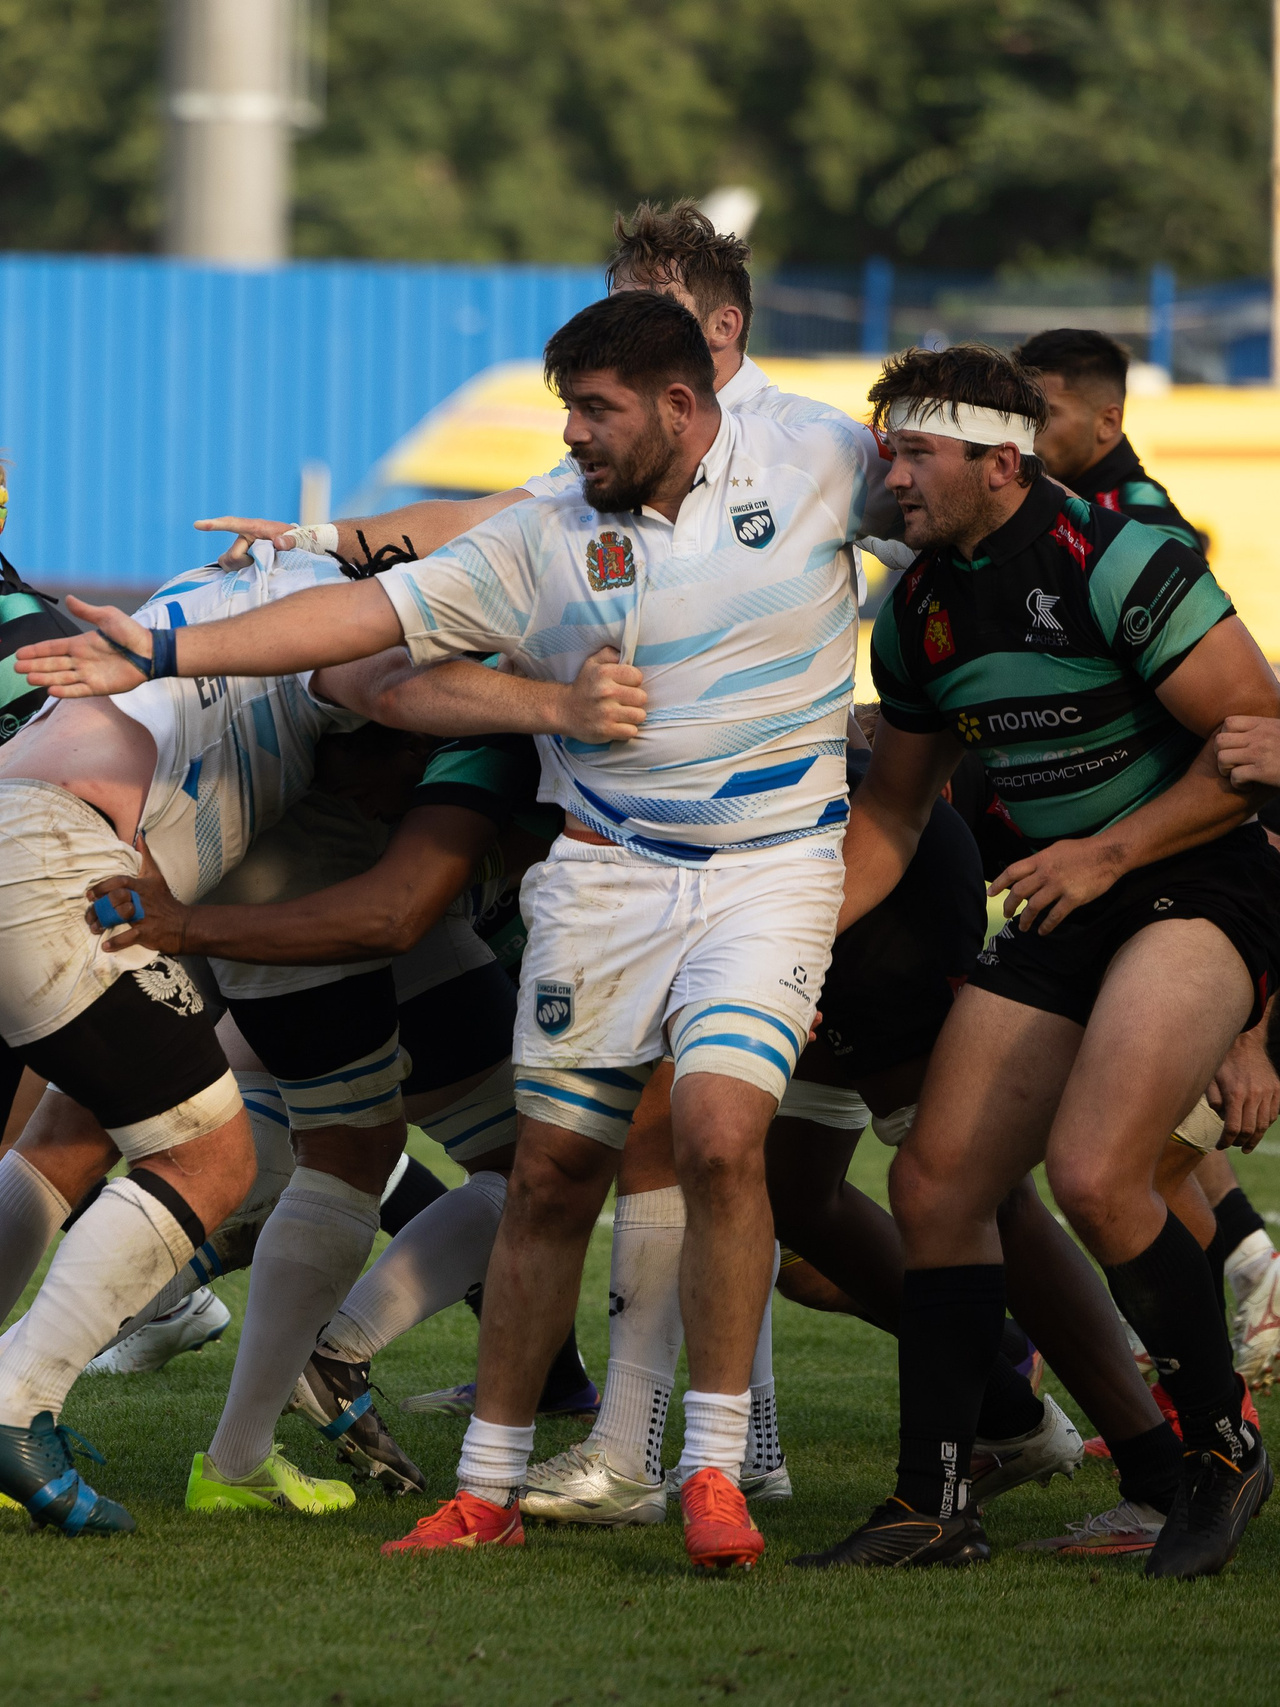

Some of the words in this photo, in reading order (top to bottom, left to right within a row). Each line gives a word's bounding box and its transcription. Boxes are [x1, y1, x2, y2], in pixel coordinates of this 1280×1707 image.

[729, 502, 754, 514] ЕНИСЕЙ
[754, 499, 769, 510] СТМ
[987, 706, 1083, 733] ПОЛЮС
[537, 983, 558, 994] ЕНИСЕЙ
[558, 984, 572, 995] СТМ
[778, 977, 812, 1002] centurion
